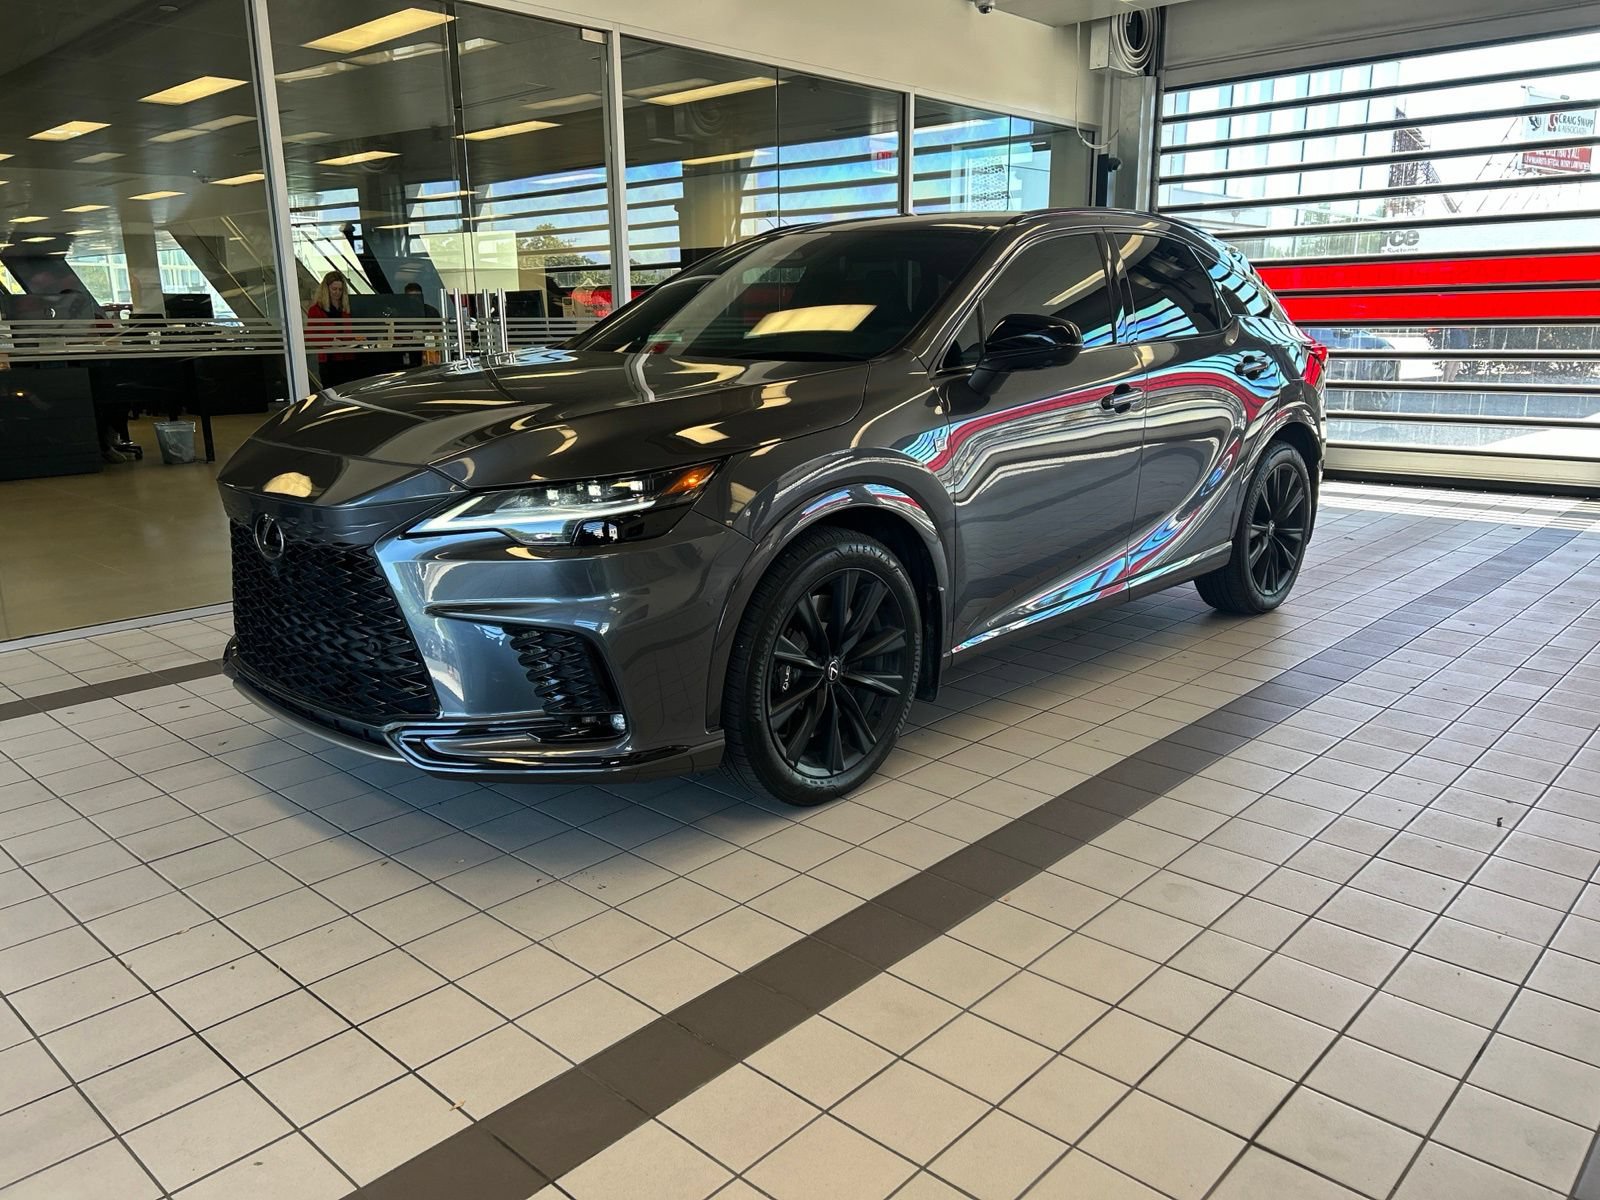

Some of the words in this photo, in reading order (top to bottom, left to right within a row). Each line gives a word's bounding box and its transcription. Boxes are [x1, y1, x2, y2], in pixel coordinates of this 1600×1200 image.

[1558, 113, 1576, 126] CRAIG
[847, 544, 892, 564] ALENZA
[894, 632, 921, 737] BRIDGESTONE
